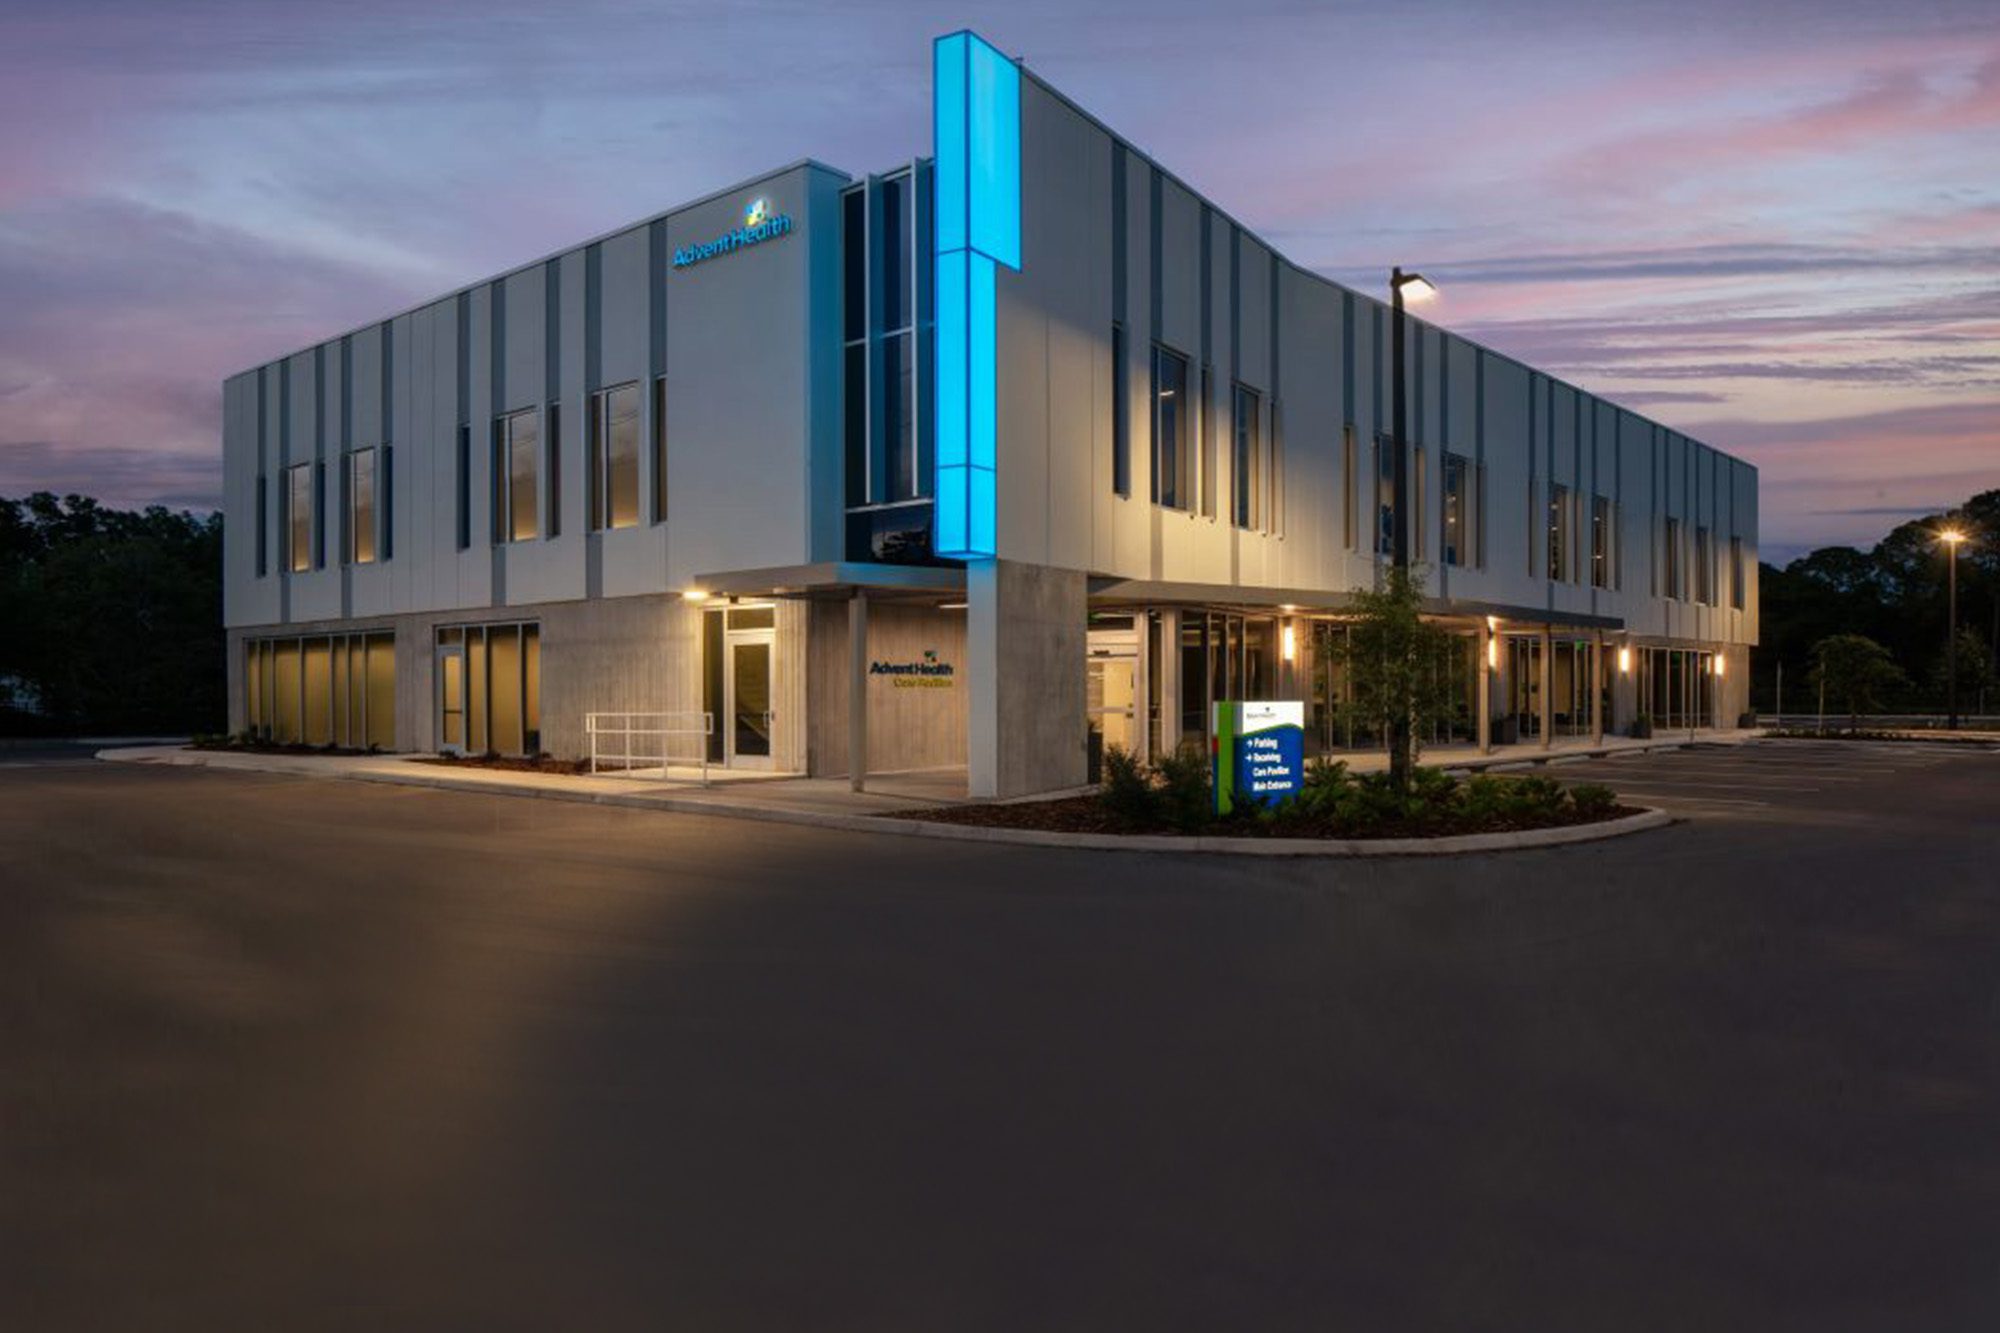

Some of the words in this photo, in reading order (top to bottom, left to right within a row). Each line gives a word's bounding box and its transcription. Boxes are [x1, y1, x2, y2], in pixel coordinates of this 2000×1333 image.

[672, 213, 791, 267] AdventHealth
[869, 661, 954, 675] AdventHealth
[1254, 738, 1278, 749] Parking
